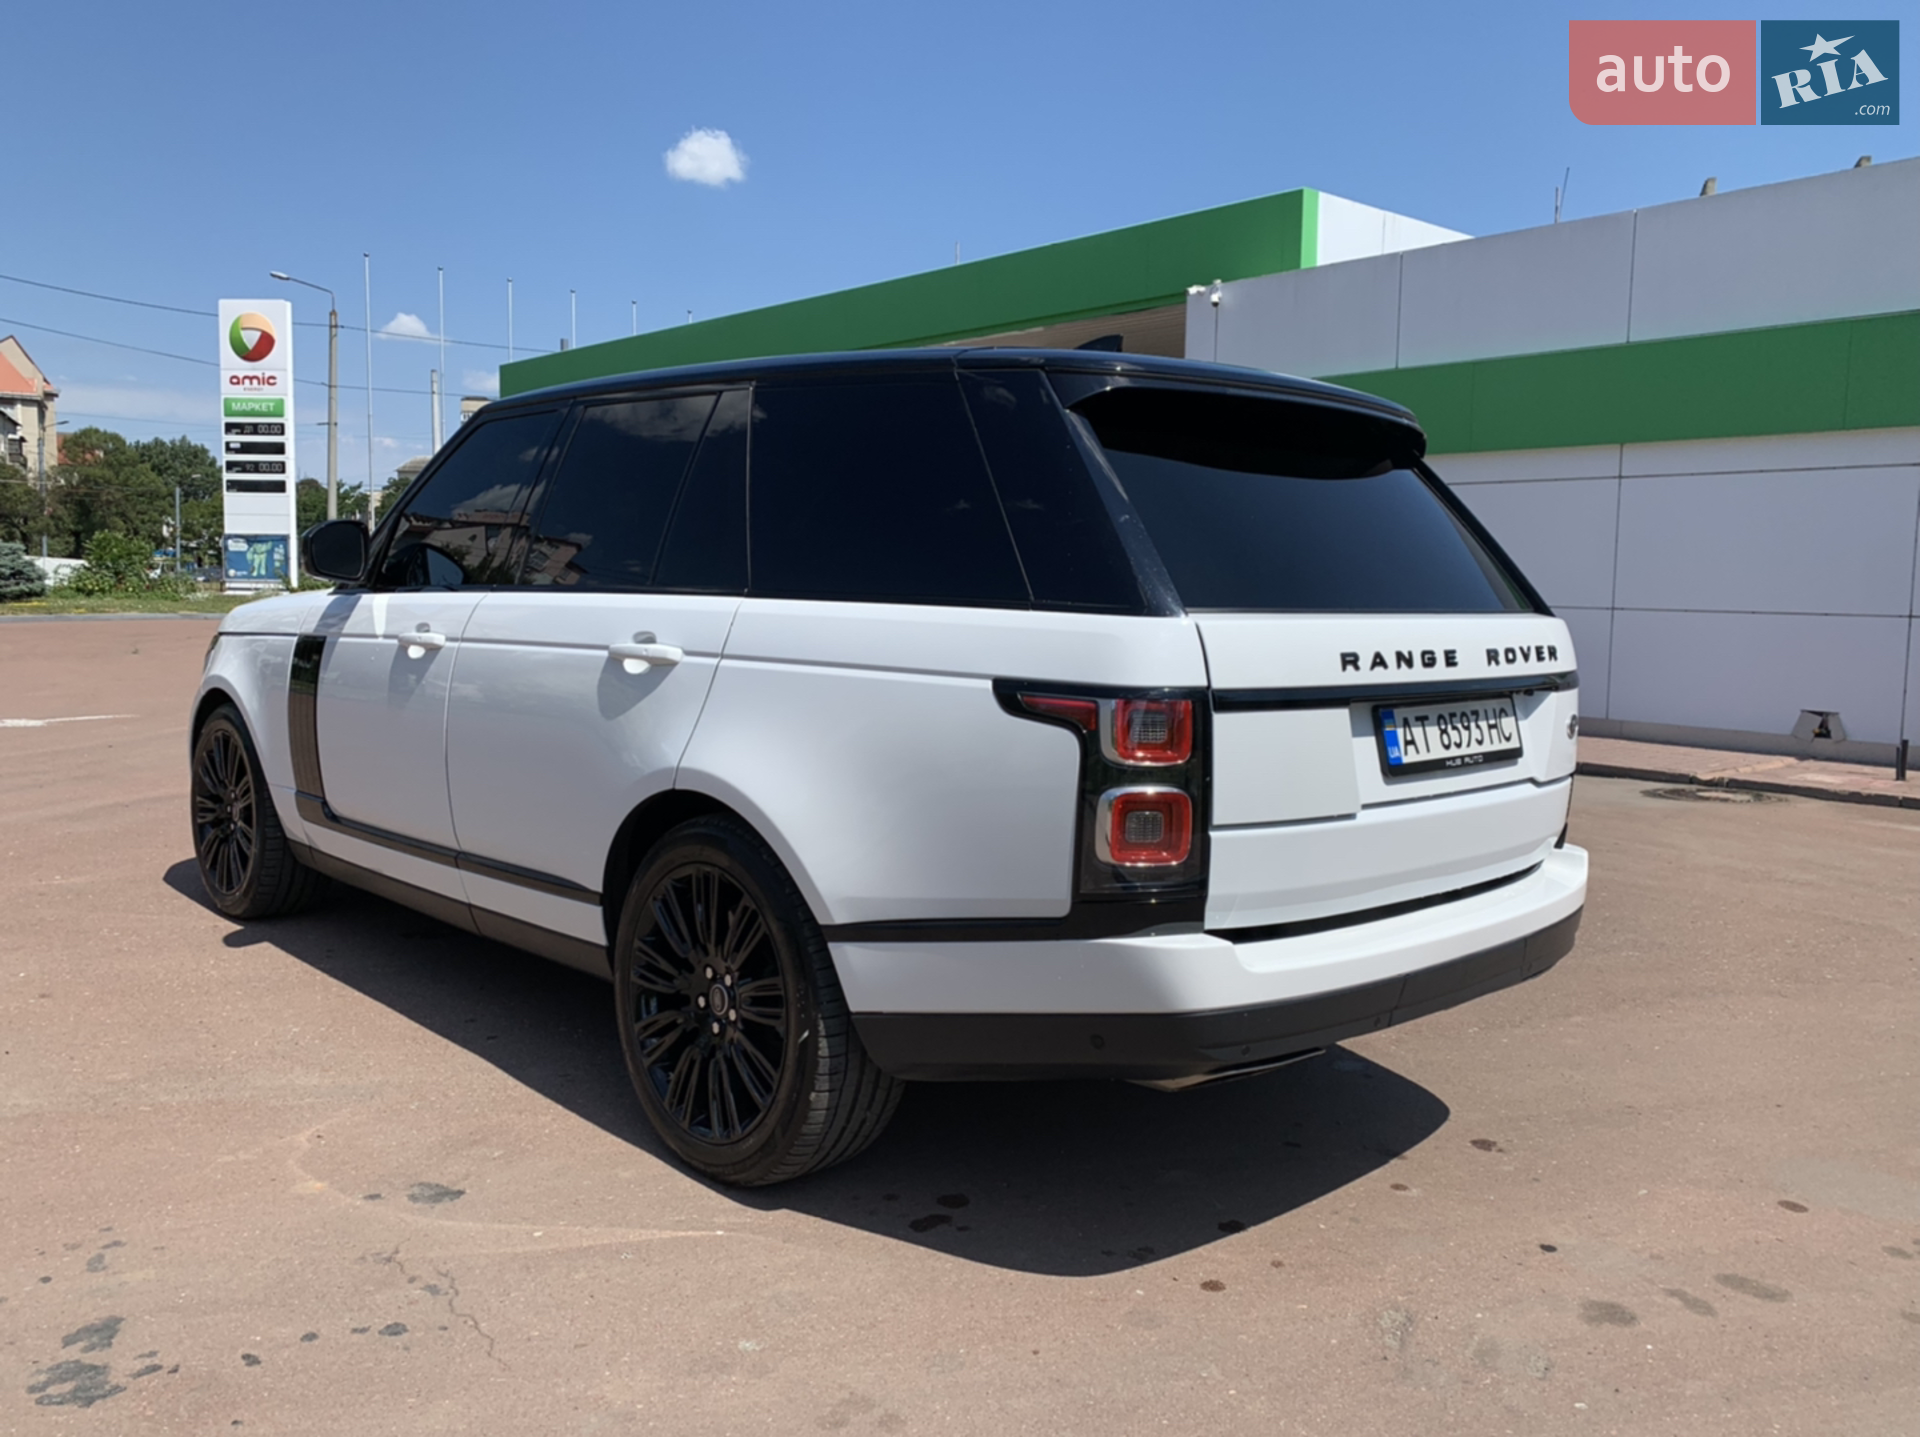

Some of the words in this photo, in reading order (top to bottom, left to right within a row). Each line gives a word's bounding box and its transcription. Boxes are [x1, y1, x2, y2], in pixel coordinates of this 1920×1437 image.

[229, 372, 277, 386] amic
[231, 402, 275, 411] МАРКЕТ
[257, 424, 282, 434] 00.00
[258, 463, 283, 472] 00.00
[1340, 649, 1459, 672] RANGE
[1485, 645, 1558, 667] ROVER
[1402, 714, 1431, 757] AT
[1437, 708, 1485, 751] 8593
[1484, 706, 1513, 746] HC
[1388, 746, 1401, 758] UA
